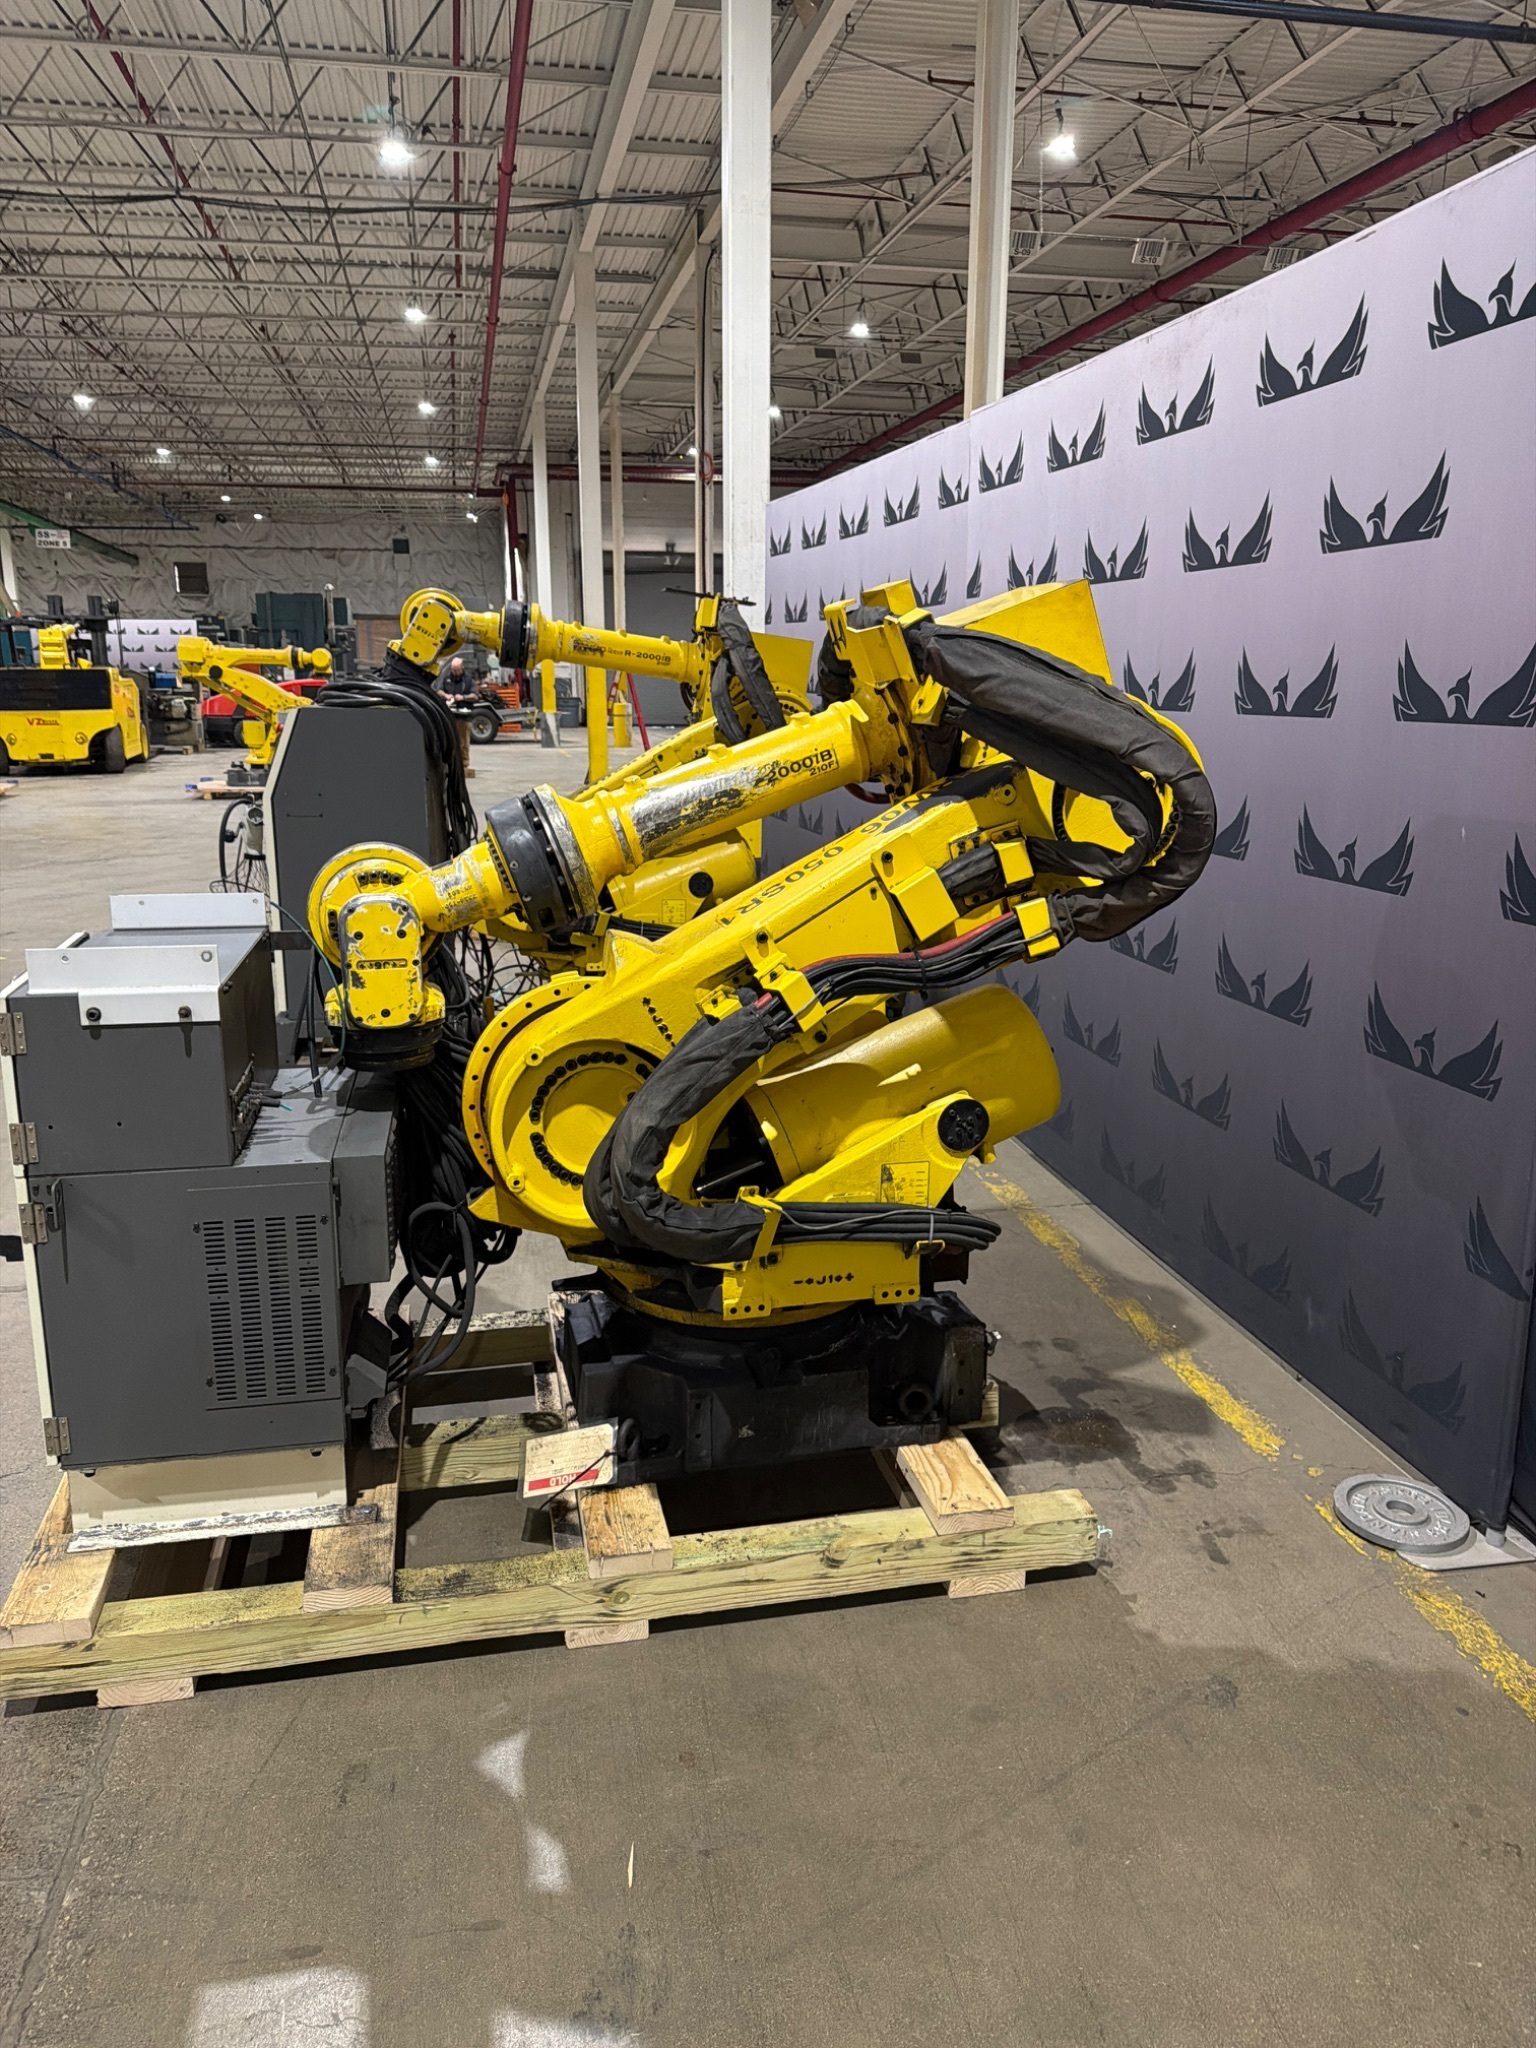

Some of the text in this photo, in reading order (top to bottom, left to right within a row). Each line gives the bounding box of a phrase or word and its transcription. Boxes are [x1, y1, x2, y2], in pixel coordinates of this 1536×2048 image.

[1014, 248, 1031, 256] S-09
[1140, 256, 1157, 264] S-10
[37, 539, 60, 547] ZONE
[663, 555, 682, 566] 17
[624, 649, 672, 662] R-2000iB
[809, 760, 835, 777] 210F
[549, 1473, 577, 1487] HOLD
